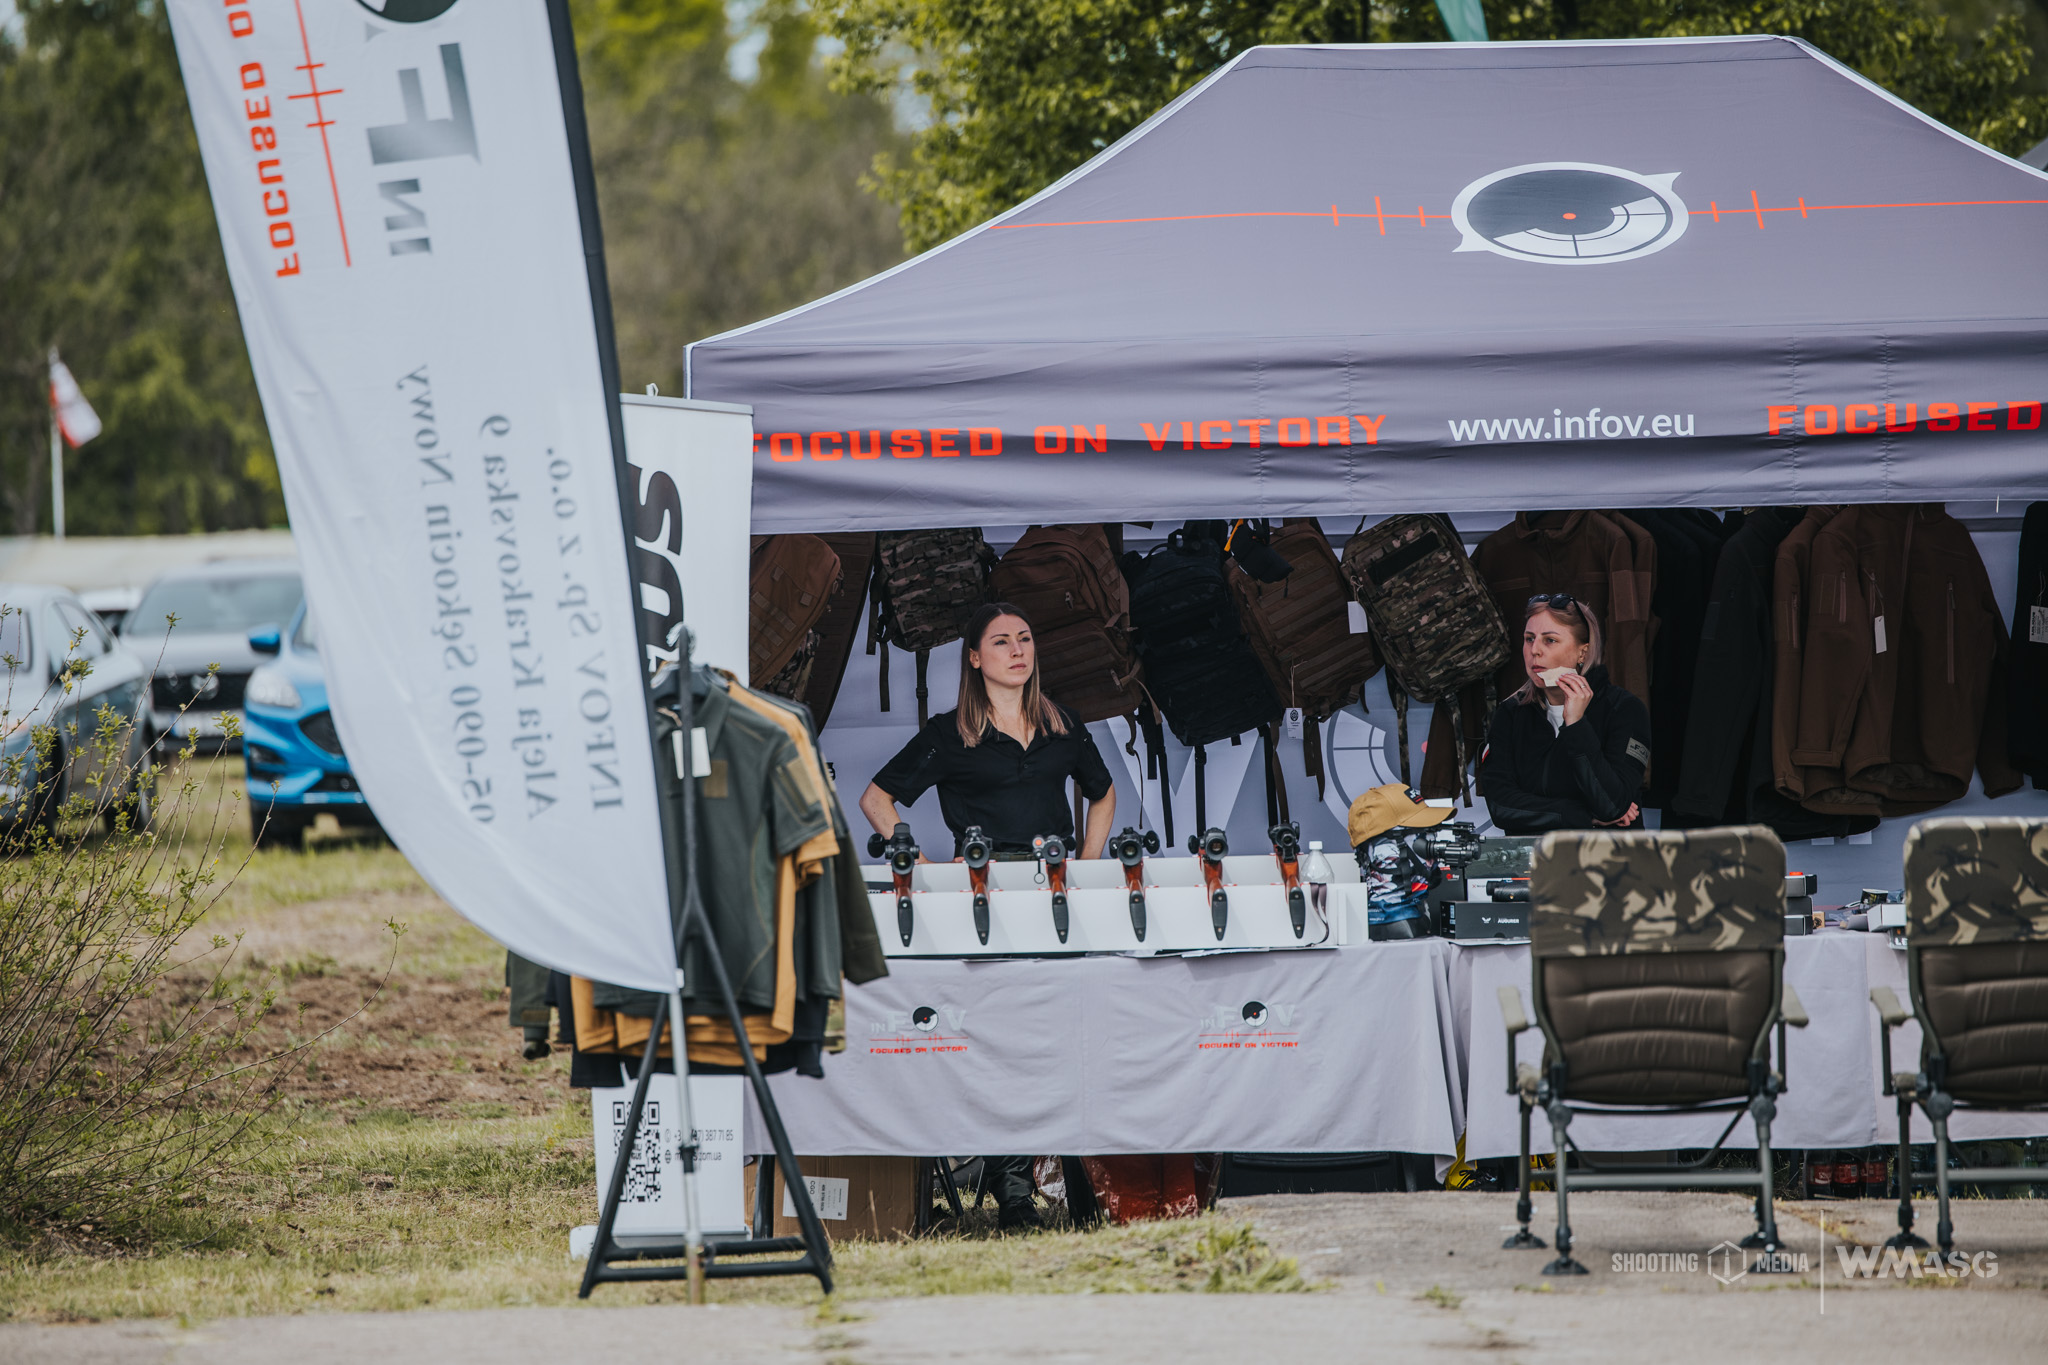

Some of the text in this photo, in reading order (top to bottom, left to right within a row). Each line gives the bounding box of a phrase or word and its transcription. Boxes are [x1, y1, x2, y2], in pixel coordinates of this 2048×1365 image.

[1033, 424, 1108, 455] ON
[1139, 414, 1388, 451] VICTORY
[1448, 407, 1696, 442] www.infov.eu
[1766, 400, 2042, 436] FOCUSED
